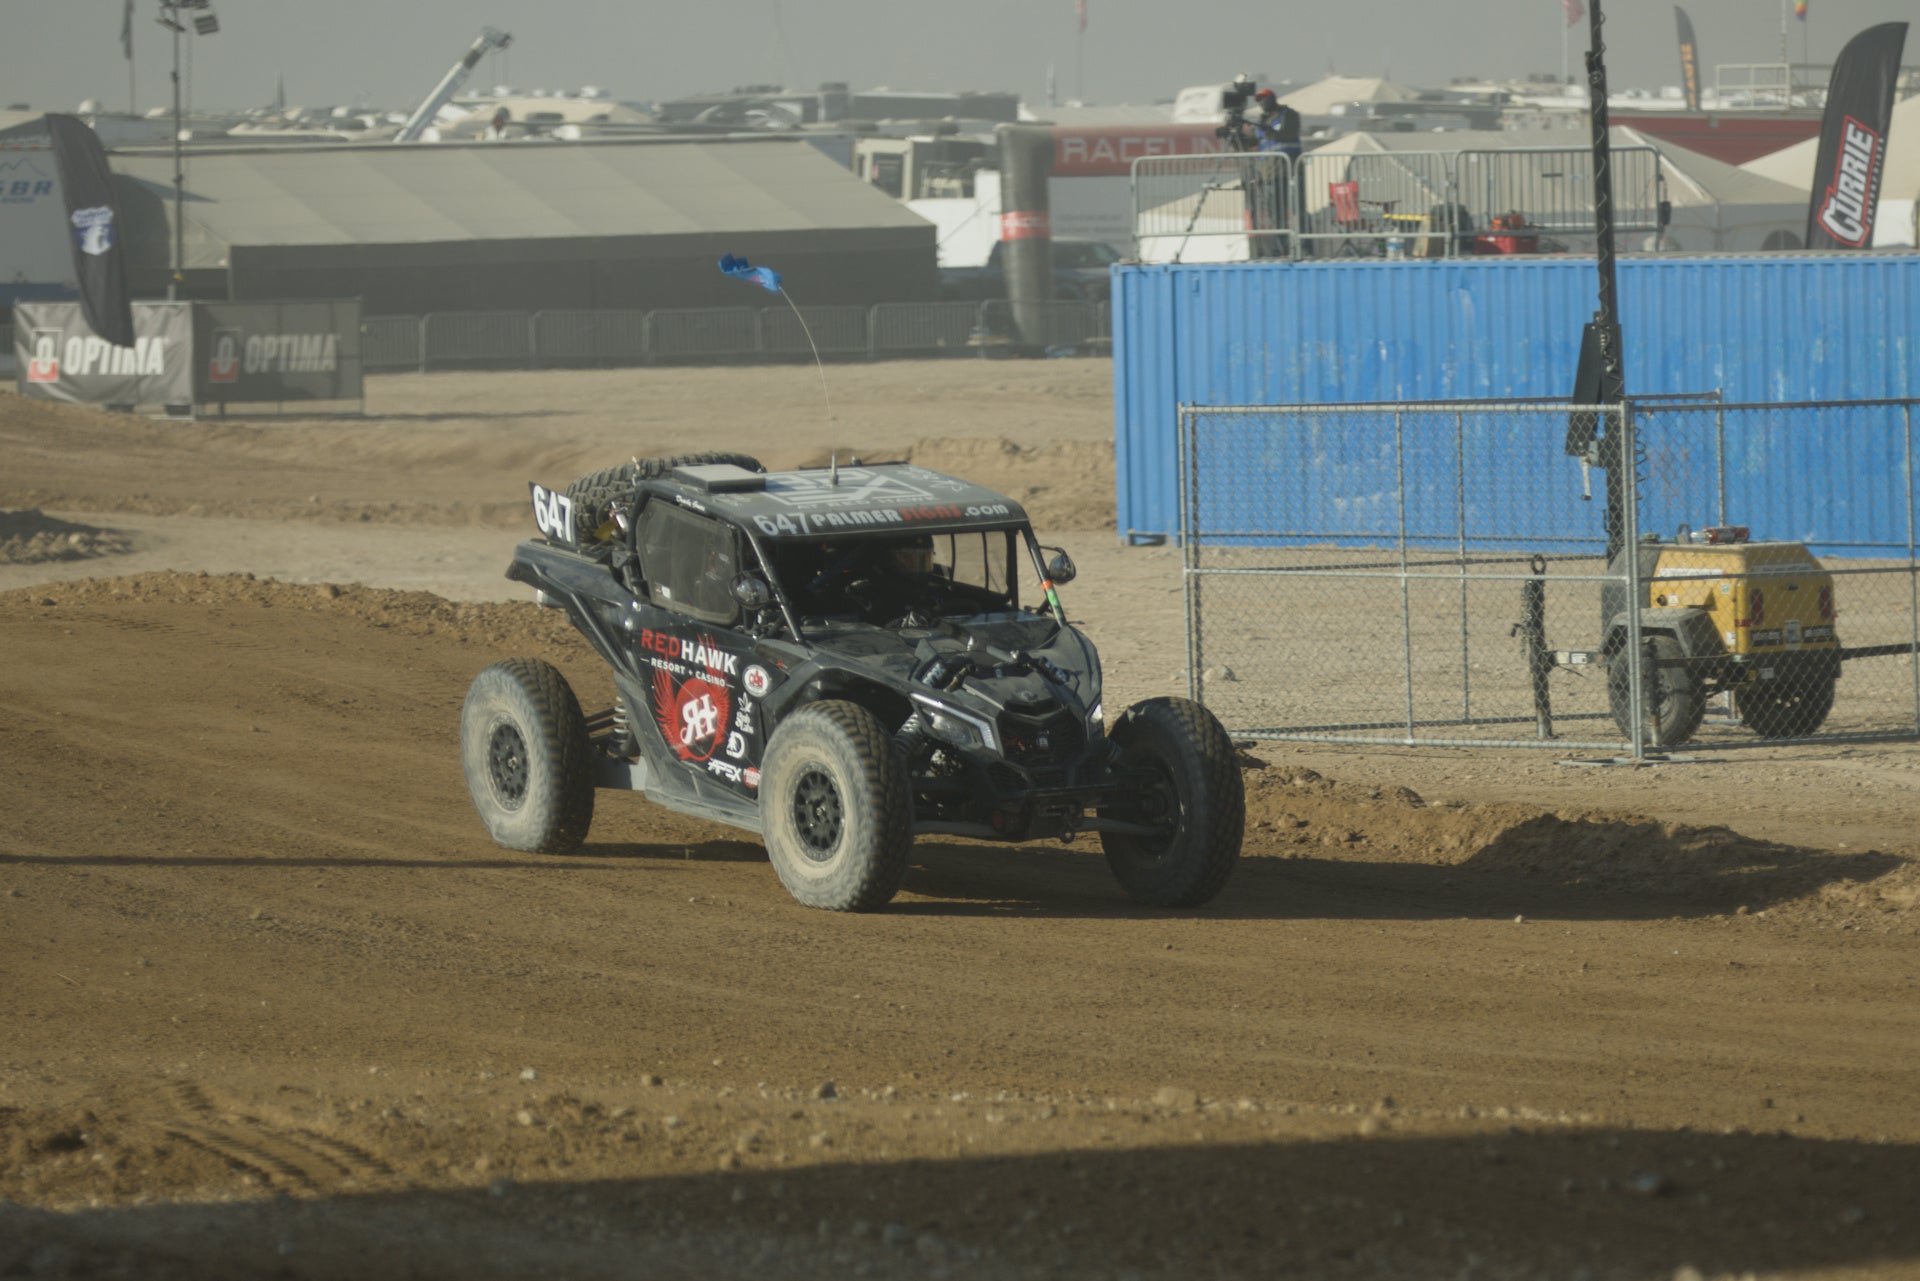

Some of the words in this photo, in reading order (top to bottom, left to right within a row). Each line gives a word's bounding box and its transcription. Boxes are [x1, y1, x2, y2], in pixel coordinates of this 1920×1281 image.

[1822, 122, 1874, 242] CURRIE
[244, 334, 337, 373] OPTIMA
[533, 485, 572, 543] 647
[752, 512, 811, 536] 647
[650, 657, 686, 676] RESORT
[695, 670, 726, 688] CASINO
